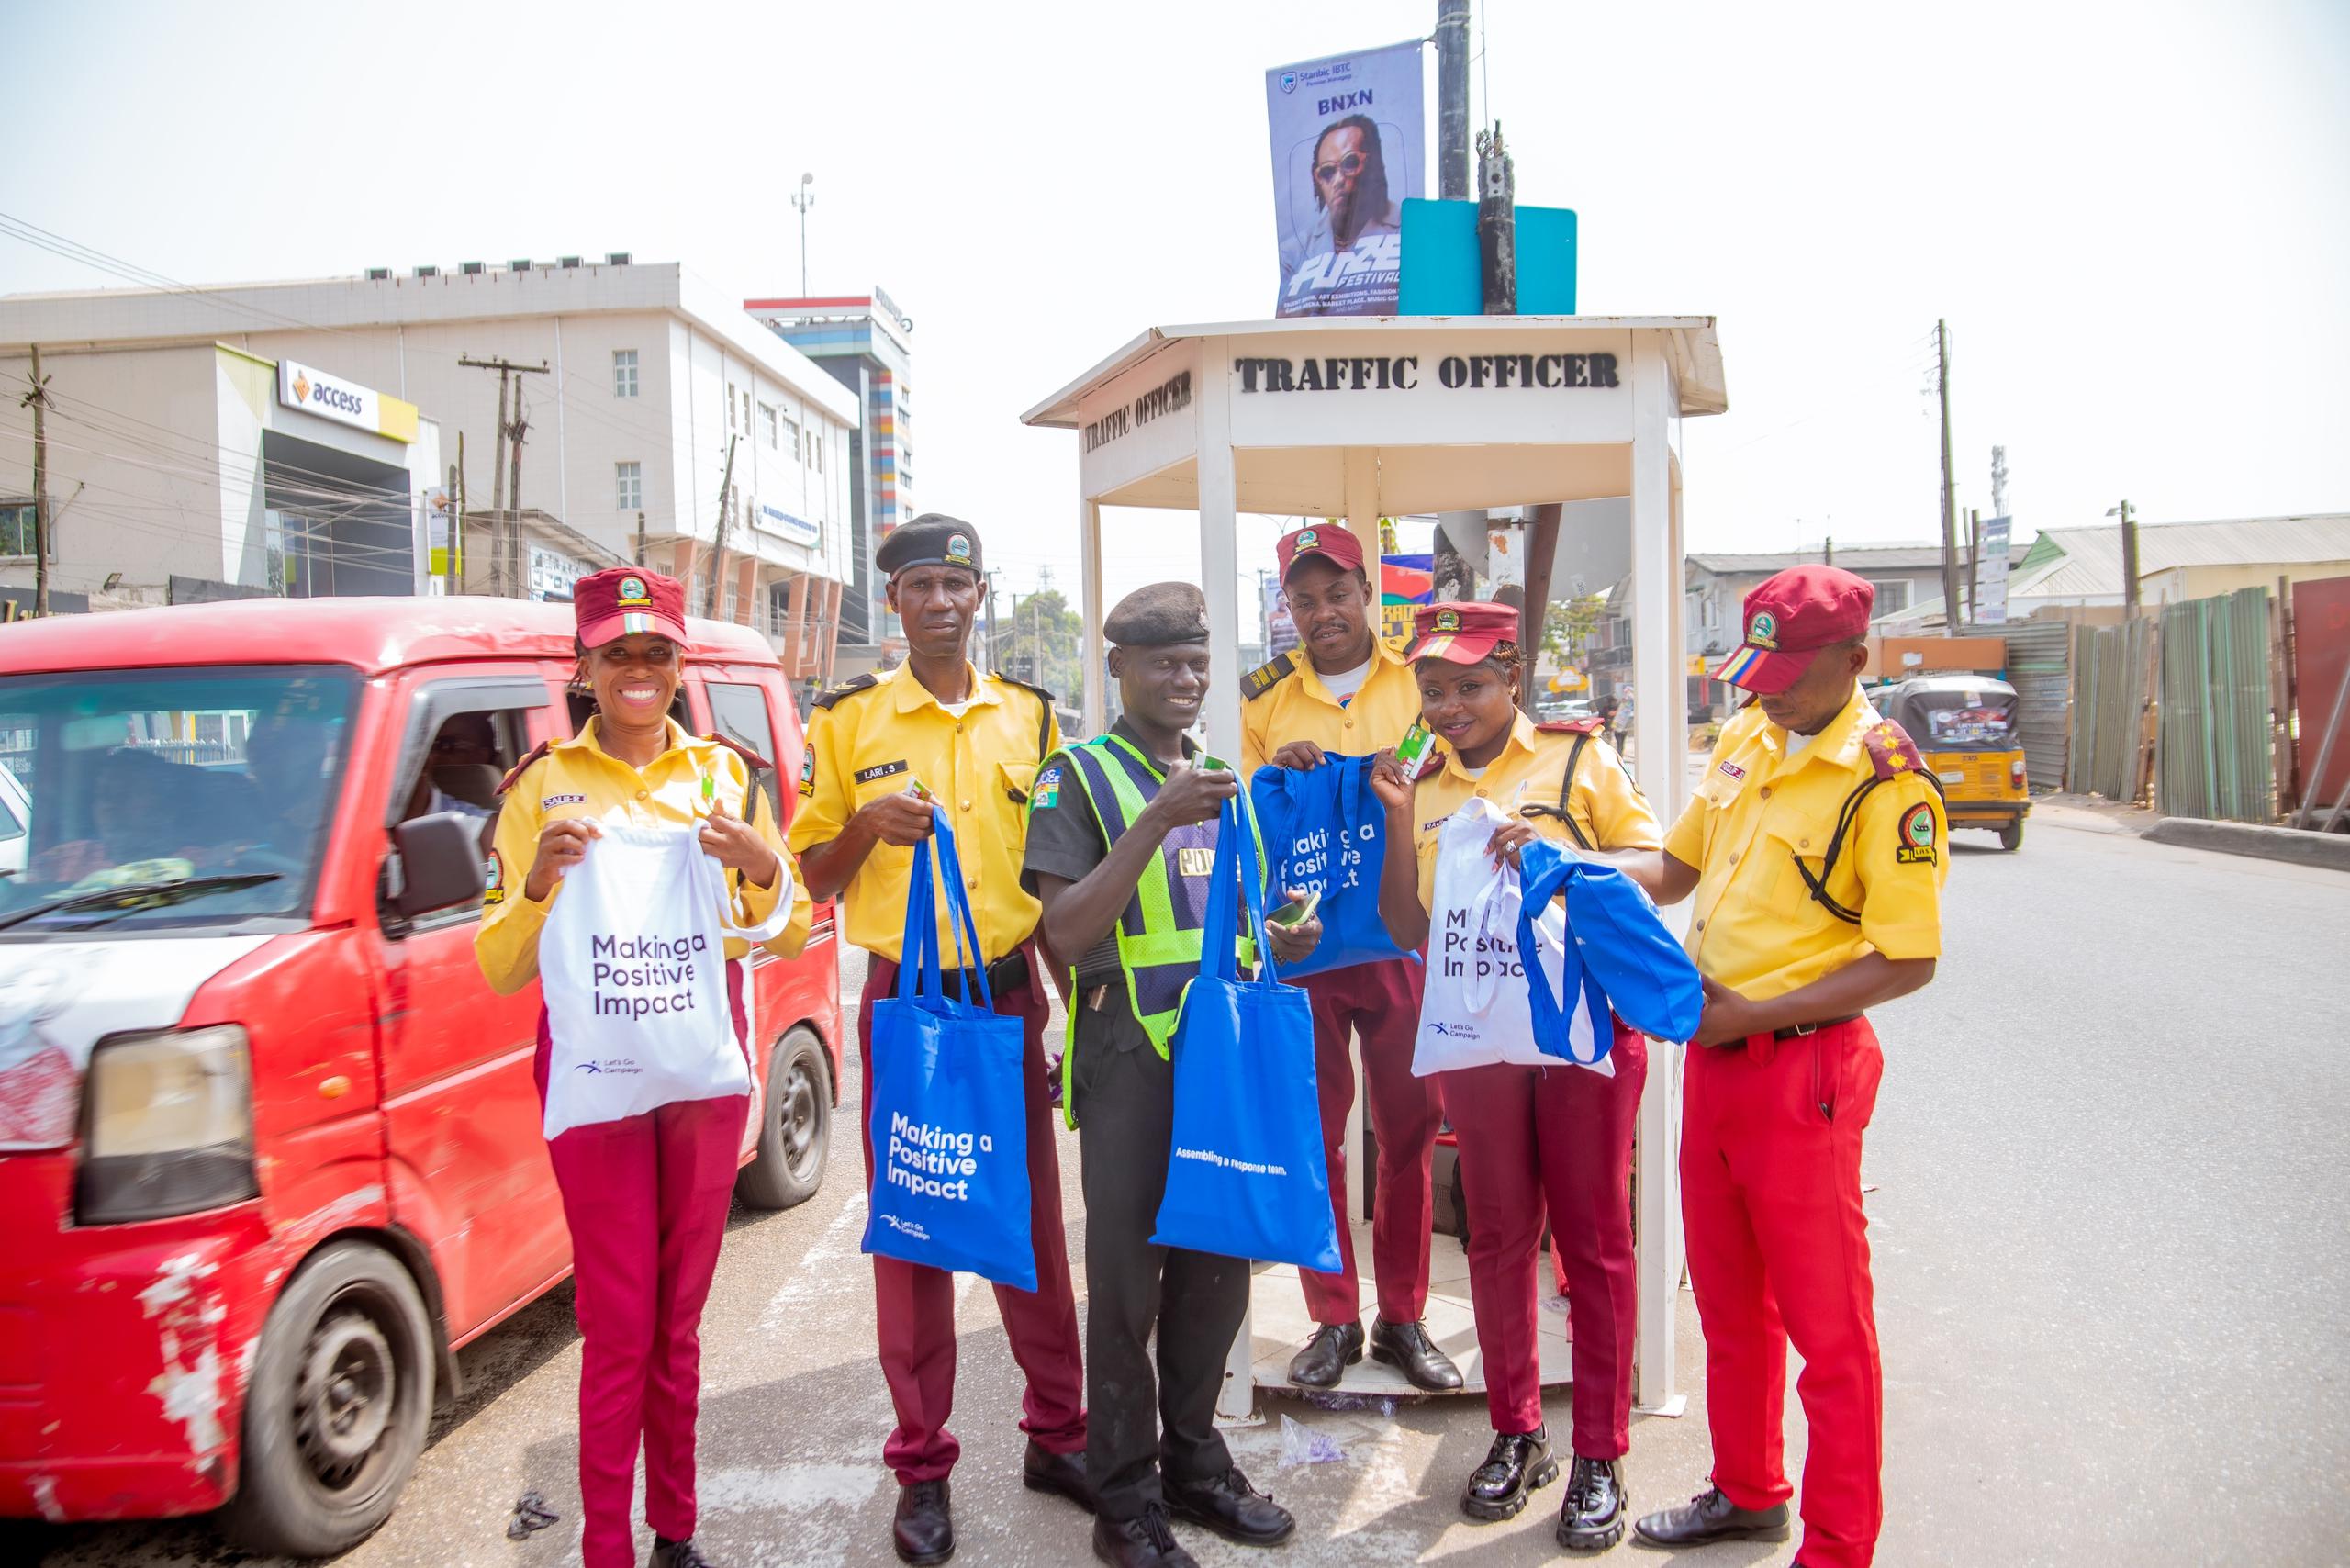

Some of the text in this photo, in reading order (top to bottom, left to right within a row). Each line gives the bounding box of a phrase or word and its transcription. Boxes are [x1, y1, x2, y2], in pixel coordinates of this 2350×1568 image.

[1300, 62, 1351, 81] Stanbic IBTC
[1318, 89, 1373, 116] BNXN
[1337, 272, 1400, 287] FESTIVAL
[1235, 353, 1620, 393] TRAFFIC OFFICER
[313, 382, 362, 415] access
[1085, 370, 1191, 454] TRAFFIC OFFICER
[1360, 823, 1375, 841] a
[594, 962, 694, 987] Positive
[595, 989, 695, 1021] Impact
[1450, 1031, 1481, 1039] Campaign
[891, 1111, 993, 1157] Making a
[889, 1136, 977, 1176] Positive
[1176, 1147, 1287, 1176] Assembling a response team.
[887, 1159, 968, 1201] Impact
[901, 1226, 931, 1240] Campaign
